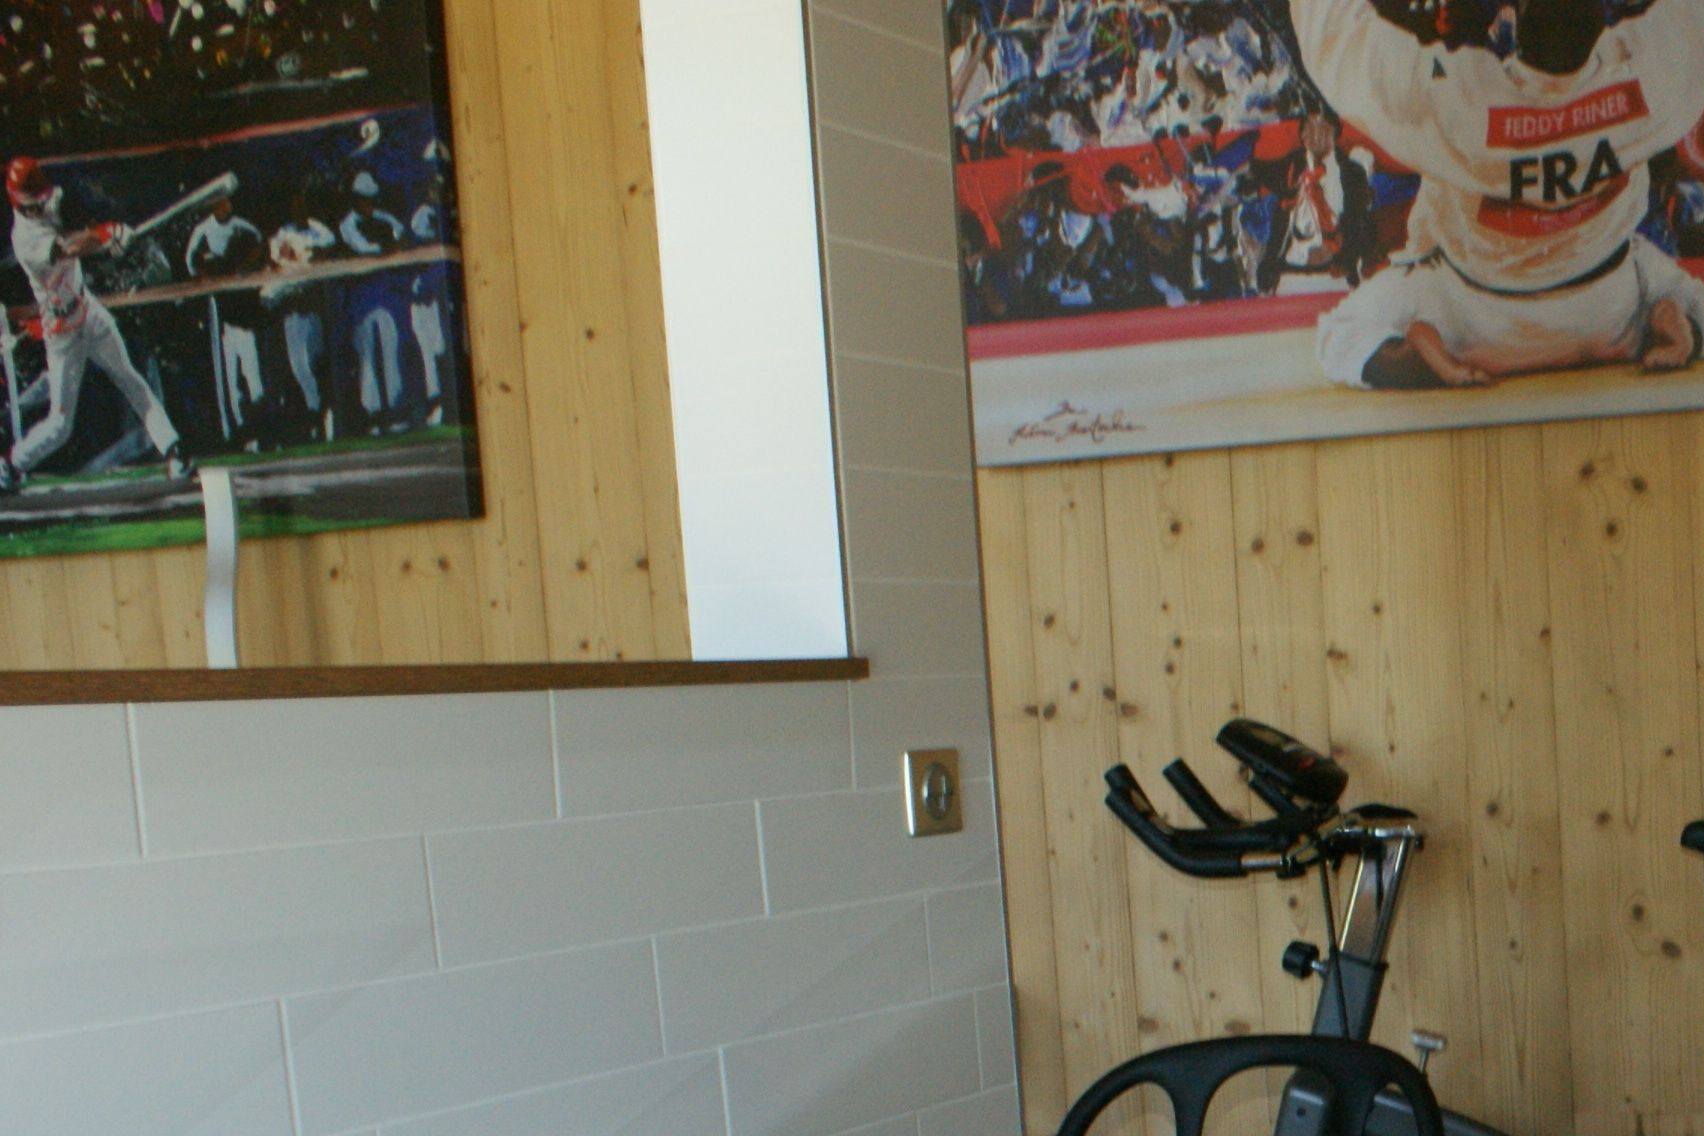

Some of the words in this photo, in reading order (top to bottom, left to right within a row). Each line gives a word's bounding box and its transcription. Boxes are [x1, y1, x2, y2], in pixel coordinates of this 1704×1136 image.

[1504, 111, 1565, 138] TEDDY
[1573, 93, 1629, 127] RINER
[1510, 139, 1622, 201] FRA
